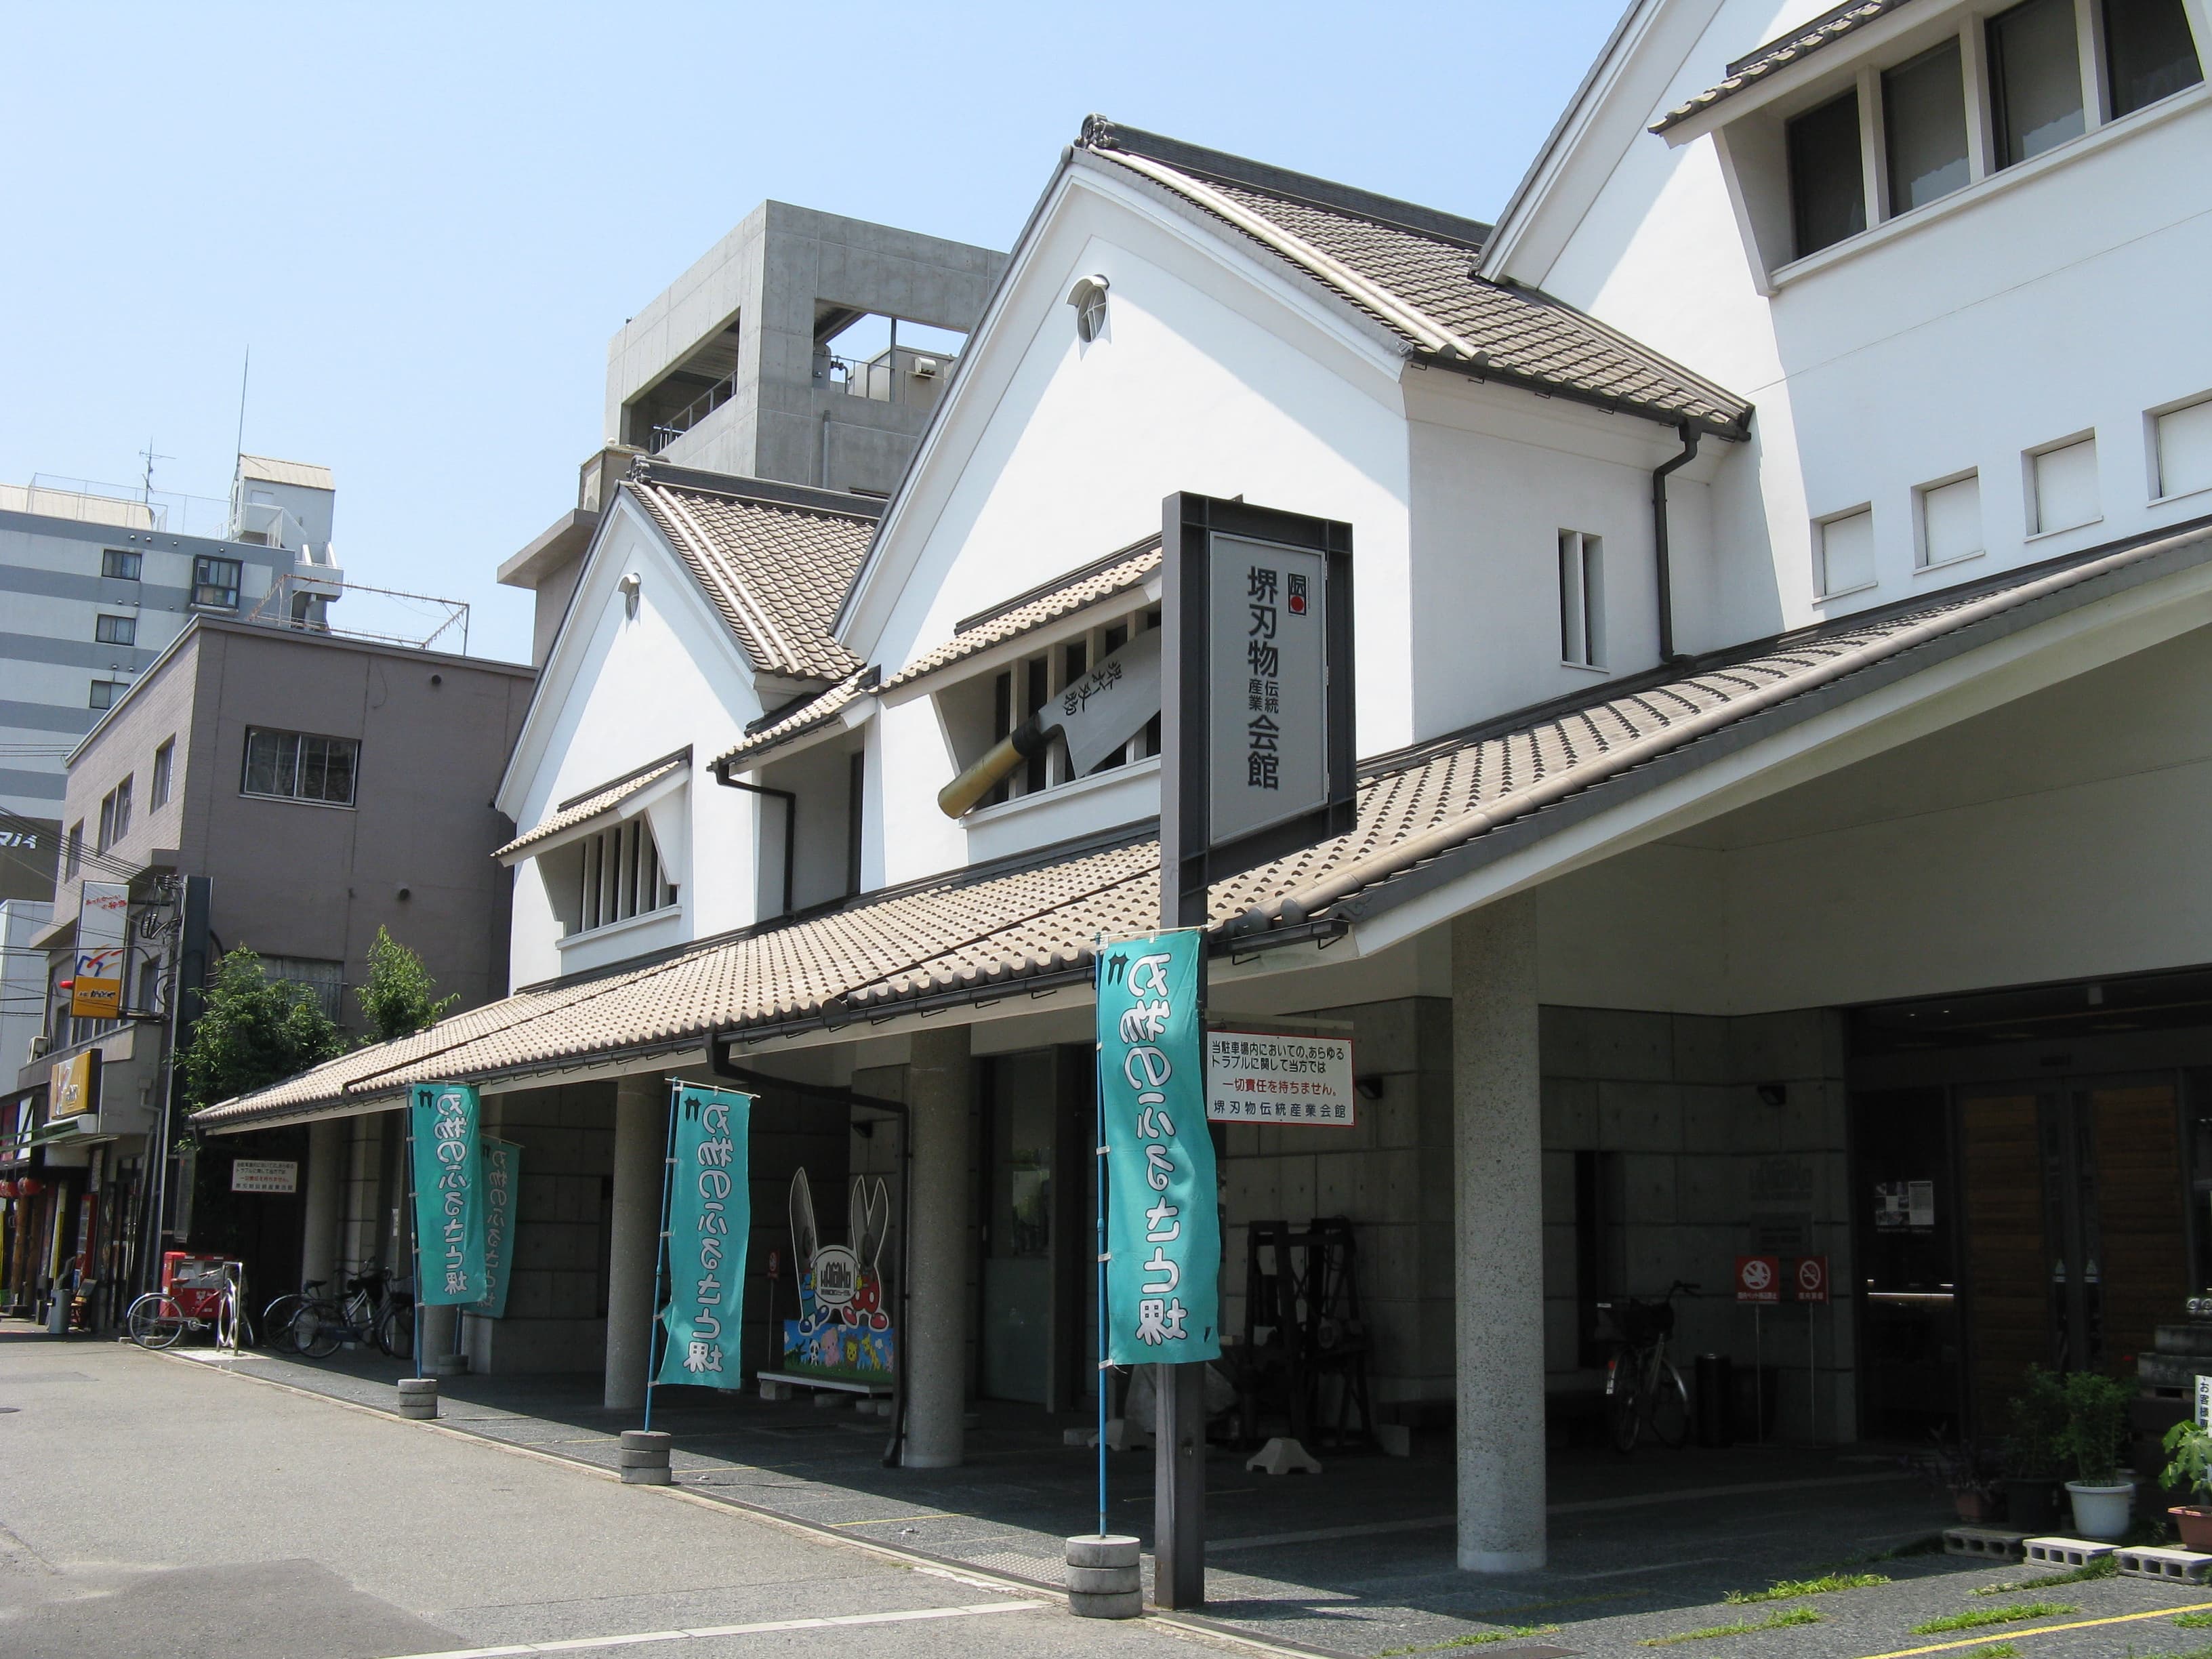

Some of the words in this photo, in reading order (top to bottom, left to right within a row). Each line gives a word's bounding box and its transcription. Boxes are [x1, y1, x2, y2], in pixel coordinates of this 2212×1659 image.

[1212, 1040, 1345, 1061] 当駐車場内においての、あらゆる
[1212, 1056, 1326, 1073] トラブルに関して当方では
[1223, 1078, 1336, 1097] 一切責任を持ちません。
[1213, 1100, 1346, 1119] 堺刃物伝統産業会館
